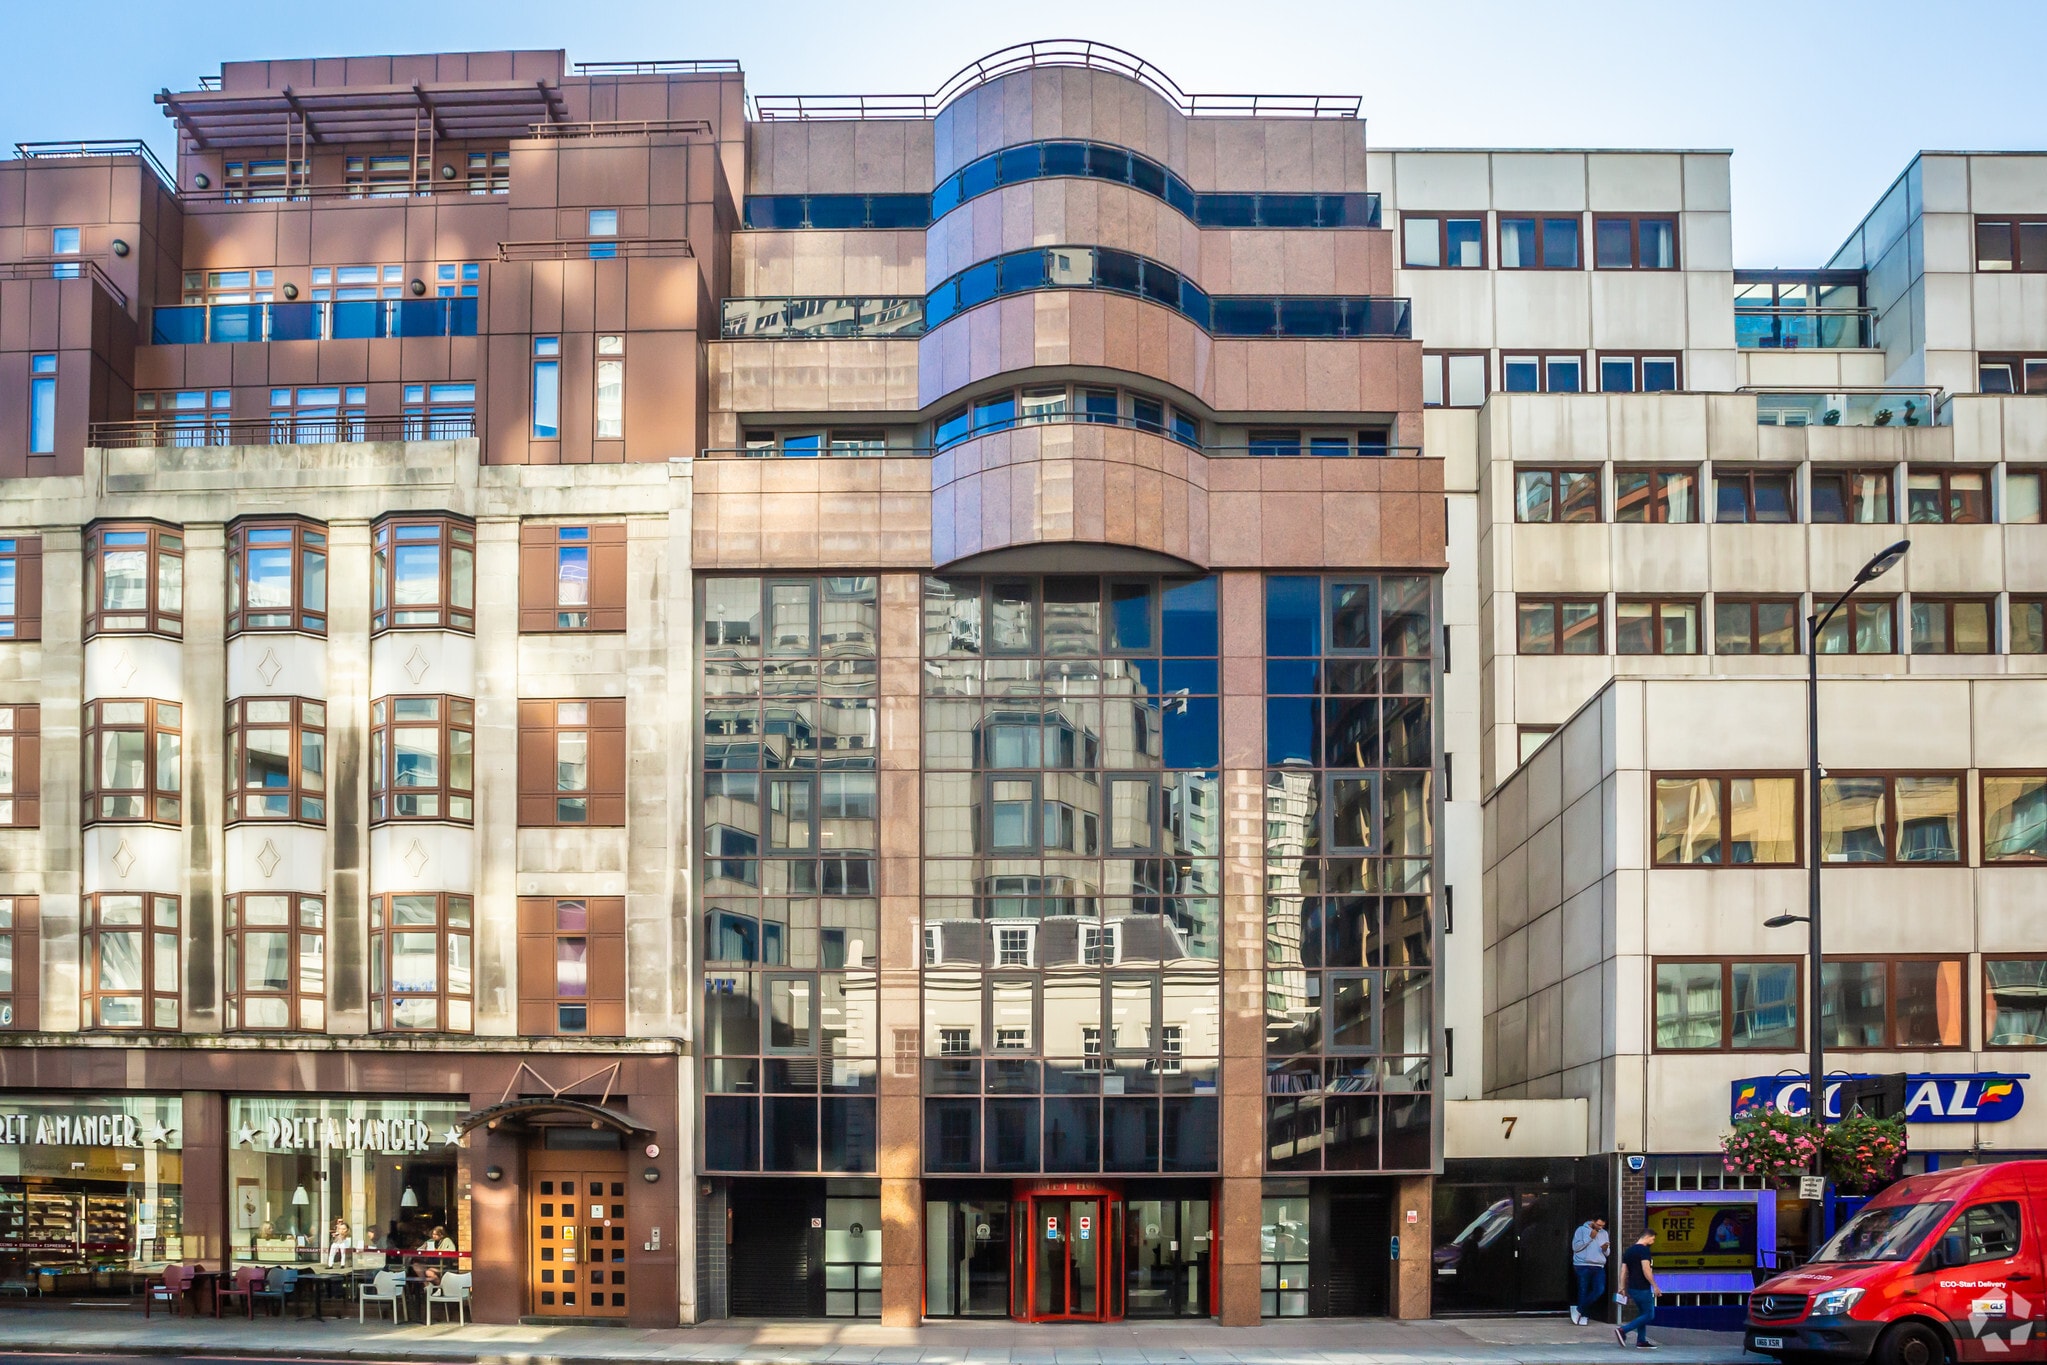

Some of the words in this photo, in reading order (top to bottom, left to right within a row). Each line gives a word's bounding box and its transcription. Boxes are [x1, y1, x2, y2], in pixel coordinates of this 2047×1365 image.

[1776, 1080, 1978, 1118] CAL
[36, 1114, 50, 1145] A
[56, 1114, 138, 1148] MANGER
[268, 1117, 317, 1149] PRET
[325, 1118, 340, 1150] A
[346, 1118, 430, 1151] MANGER
[1502, 1116, 1518, 1139] 7
[1662, 1217, 1695, 1230] FREE
[1667, 1230, 1691, 1241] BET
[1978, 1281, 2007, 1289] Delivery
